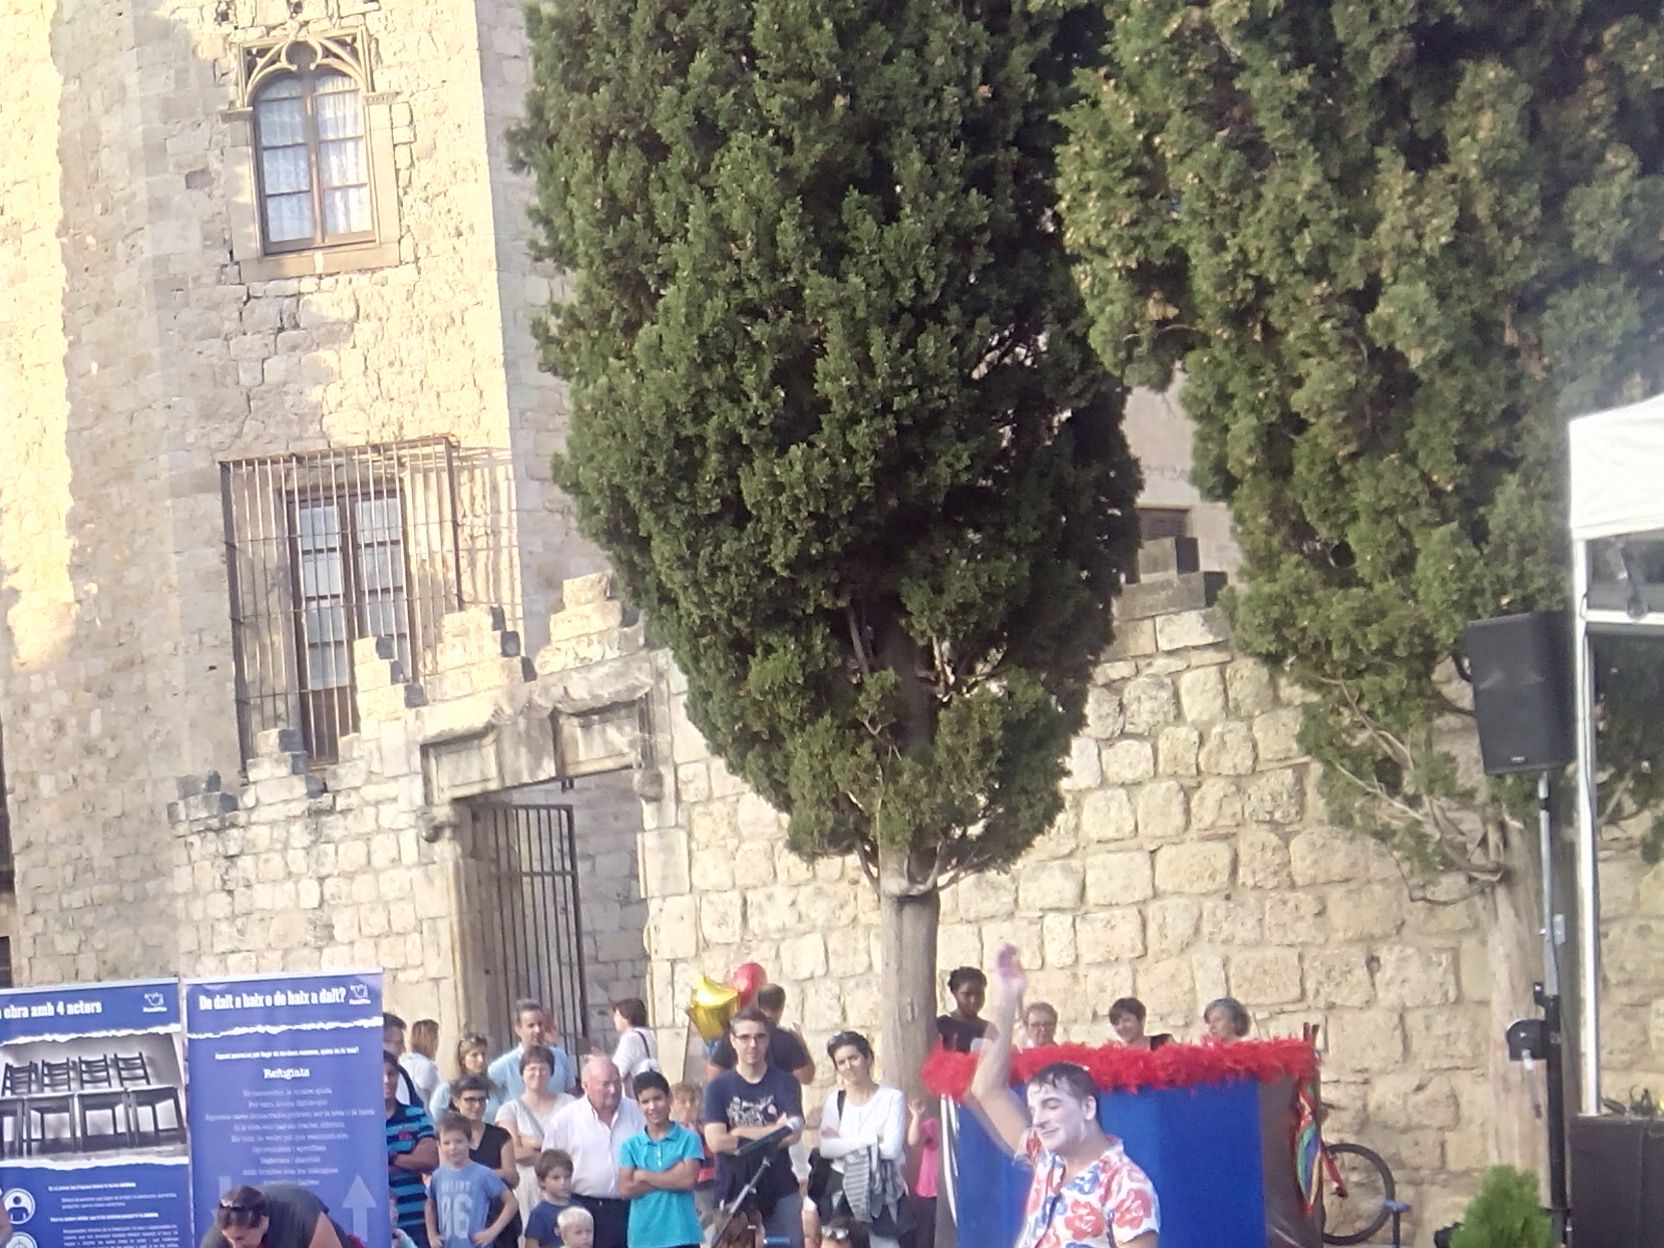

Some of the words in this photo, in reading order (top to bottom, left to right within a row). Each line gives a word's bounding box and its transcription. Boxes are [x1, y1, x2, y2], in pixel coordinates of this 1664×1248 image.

[199, 996, 212, 1010] De
[214, 994, 233, 1009] dalt
[235, 997, 242, 1008] a
[242, 993, 264, 1007] baix
[274, 991, 286, 1006] de
[287, 990, 310, 1005] baix
[311, 993, 319, 1004] a
[319, 987, 347, 1003] dalt?
[4, 1003, 28, 1018] obra
[31, 1002, 54, 1017] amb
[56, 1001, 65, 1015] 4
[66, 1001, 103, 1015] actors
